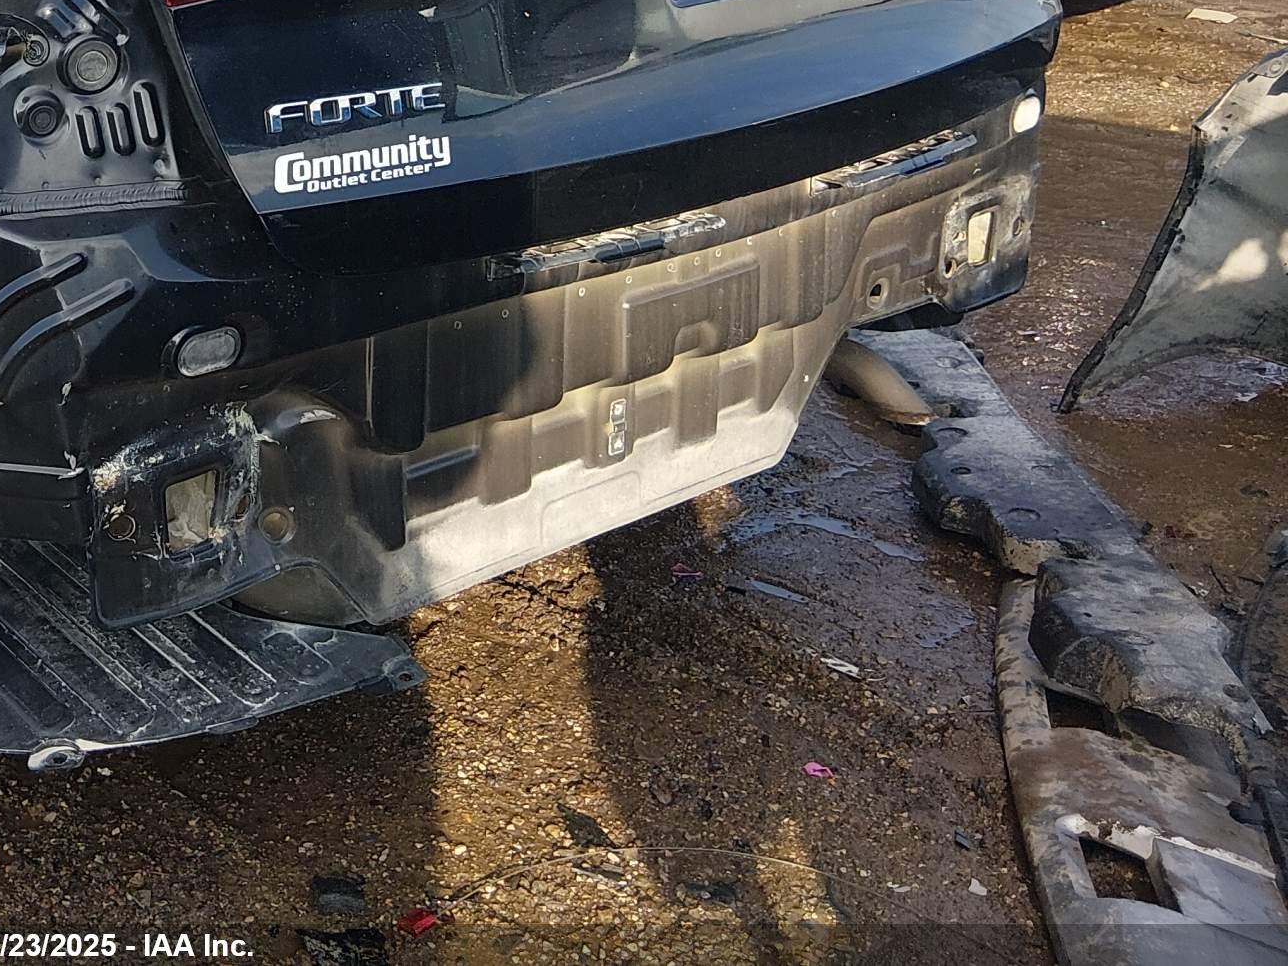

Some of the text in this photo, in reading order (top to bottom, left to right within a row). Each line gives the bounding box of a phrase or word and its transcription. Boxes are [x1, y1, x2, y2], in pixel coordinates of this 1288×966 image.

[264, 82, 445, 134] FORTE
[274, 134, 452, 194] Community
[307, 162, 432, 193] Outlet Center
